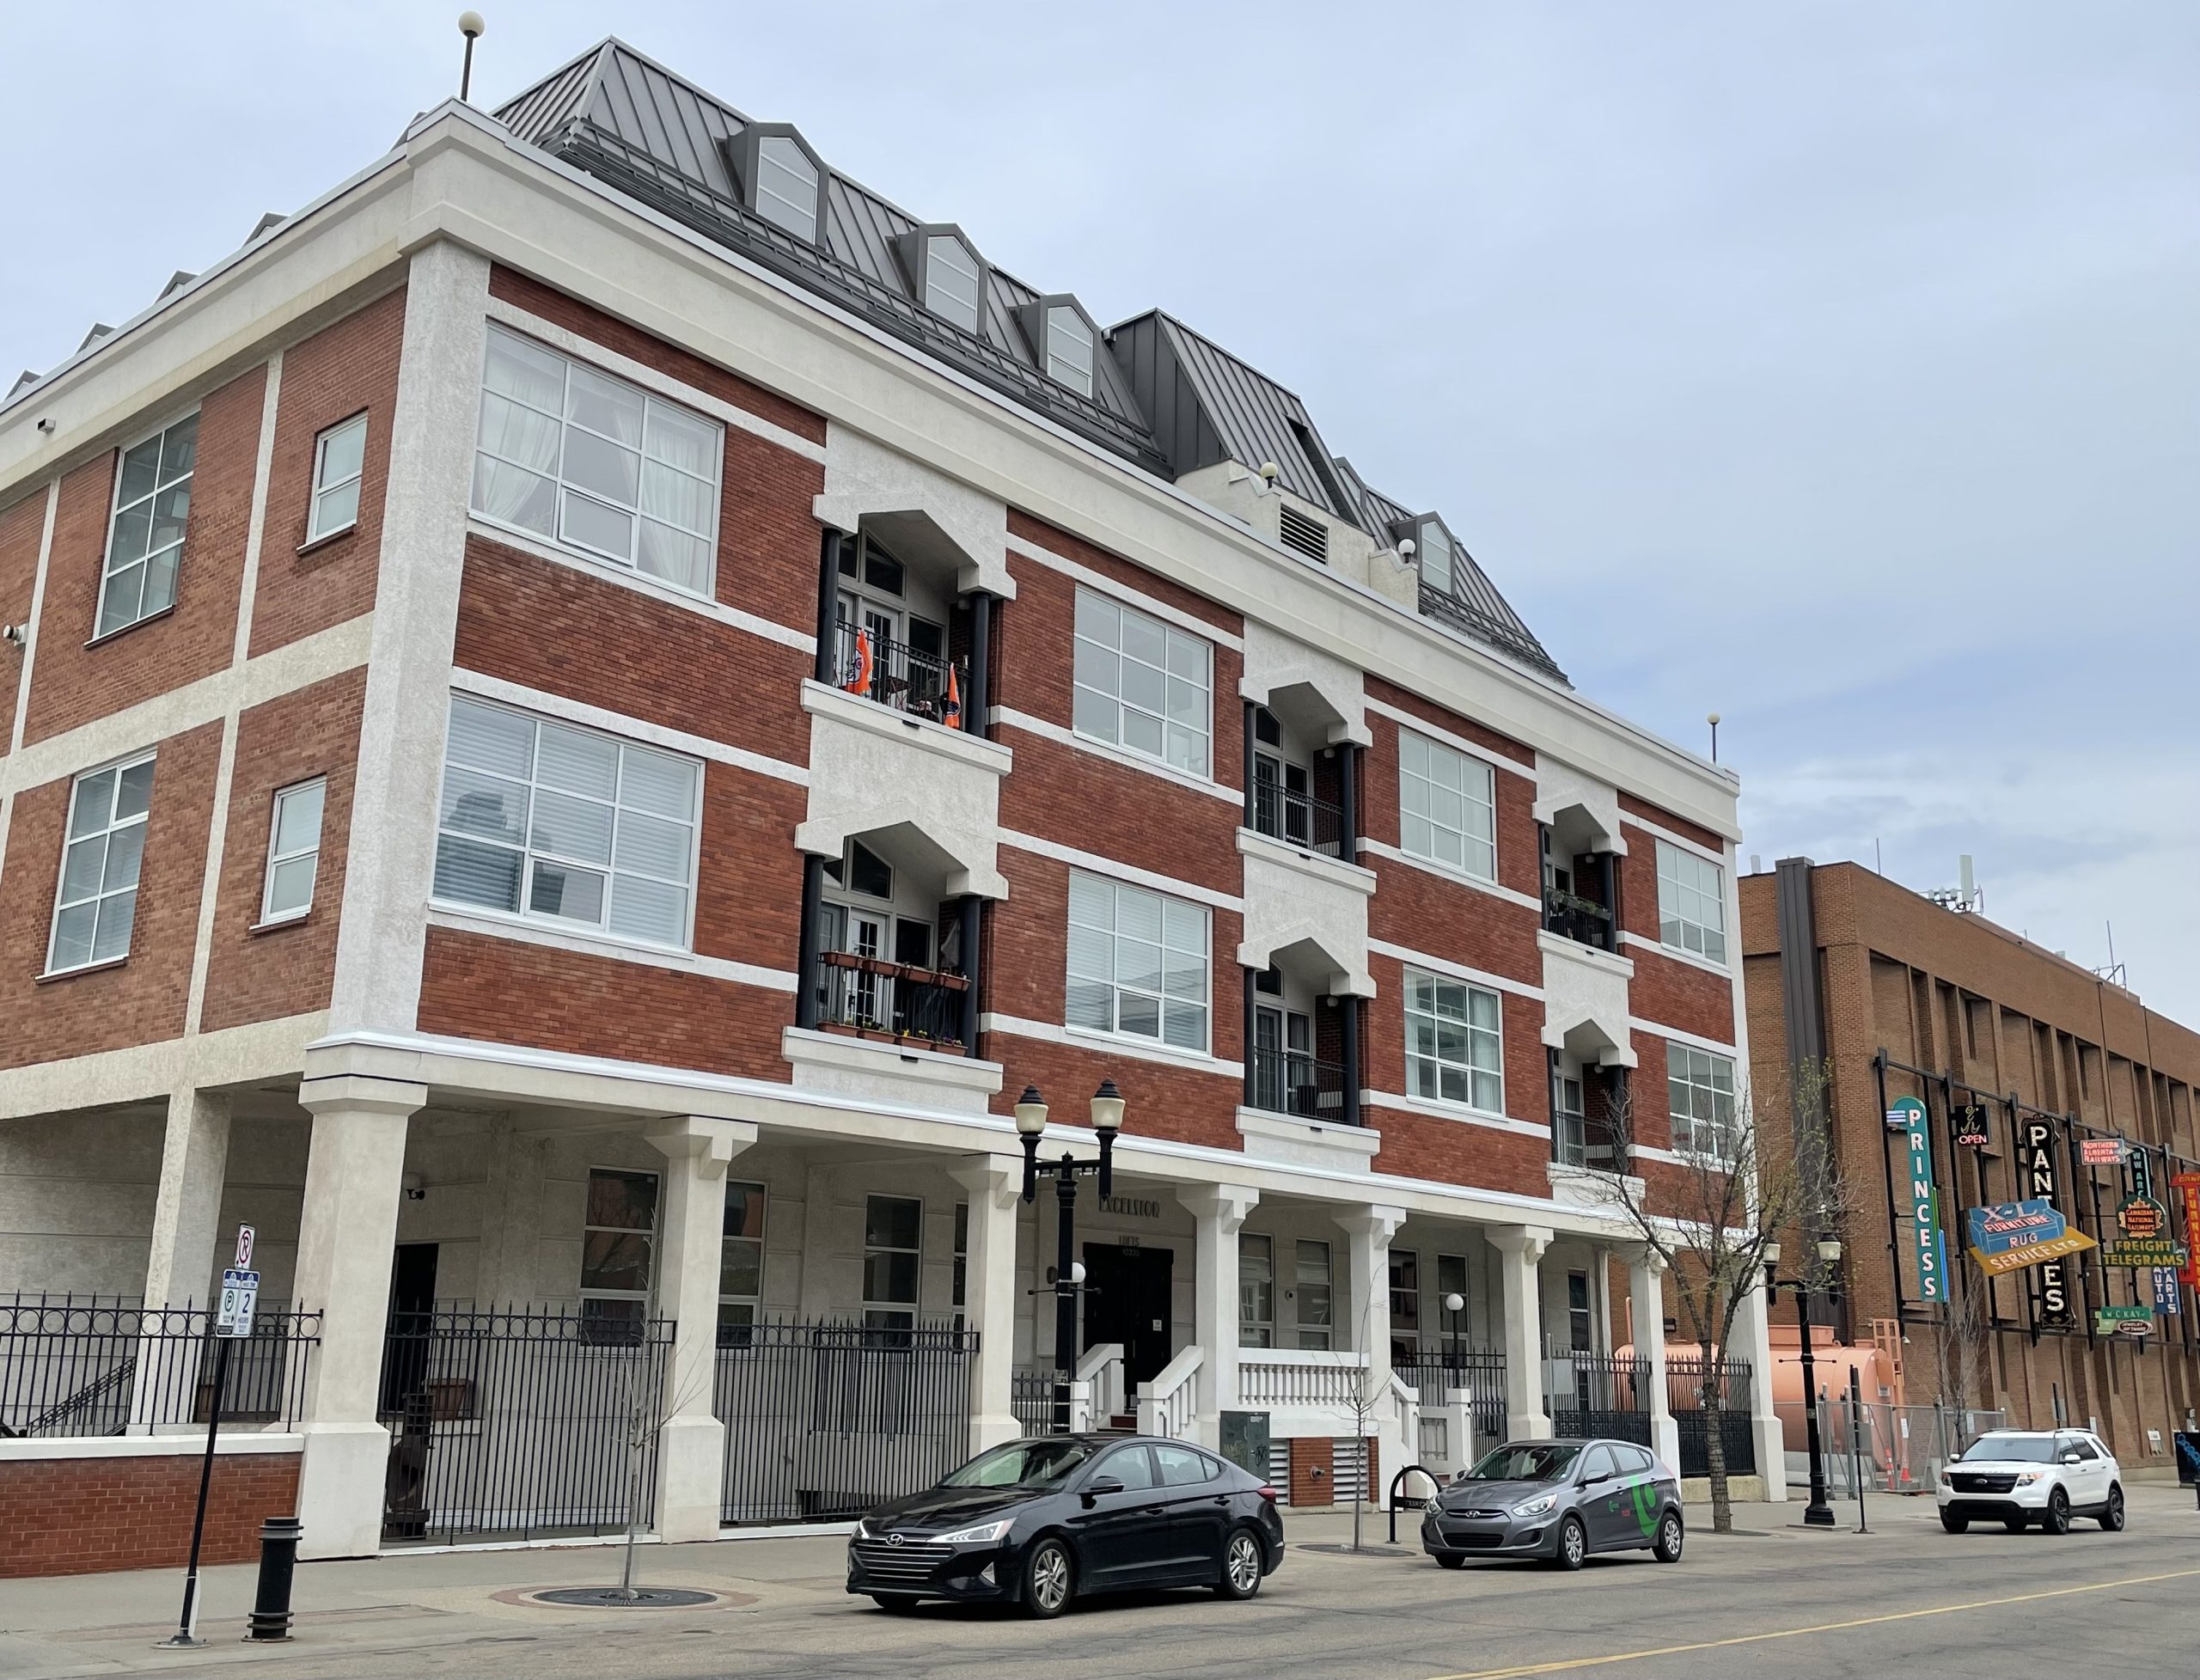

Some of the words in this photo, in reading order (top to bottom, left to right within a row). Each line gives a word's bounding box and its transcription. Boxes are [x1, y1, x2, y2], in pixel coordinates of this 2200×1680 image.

[1959, 1134, 1987, 1144] OPEN
[2082, 1140, 2119, 1149] NORTHERN
[1098, 1196, 1160, 1219] EXCELSIOR
[1909, 1109, 1936, 1296] PRINCESS
[1980, 1203, 2038, 1224] X-L
[1983, 1214, 2050, 1233] FURNITURE
[2030, 1126, 2064, 1311] PANES
[2008, 1232, 2038, 1248] RUG
[2115, 1240, 2172, 1251] FREIGHT
[1989, 1245, 2051, 1270] SERVICE
[2102, 1254, 2185, 1266] TELEGRAMS
[242, 1292, 250, 1314] 2
